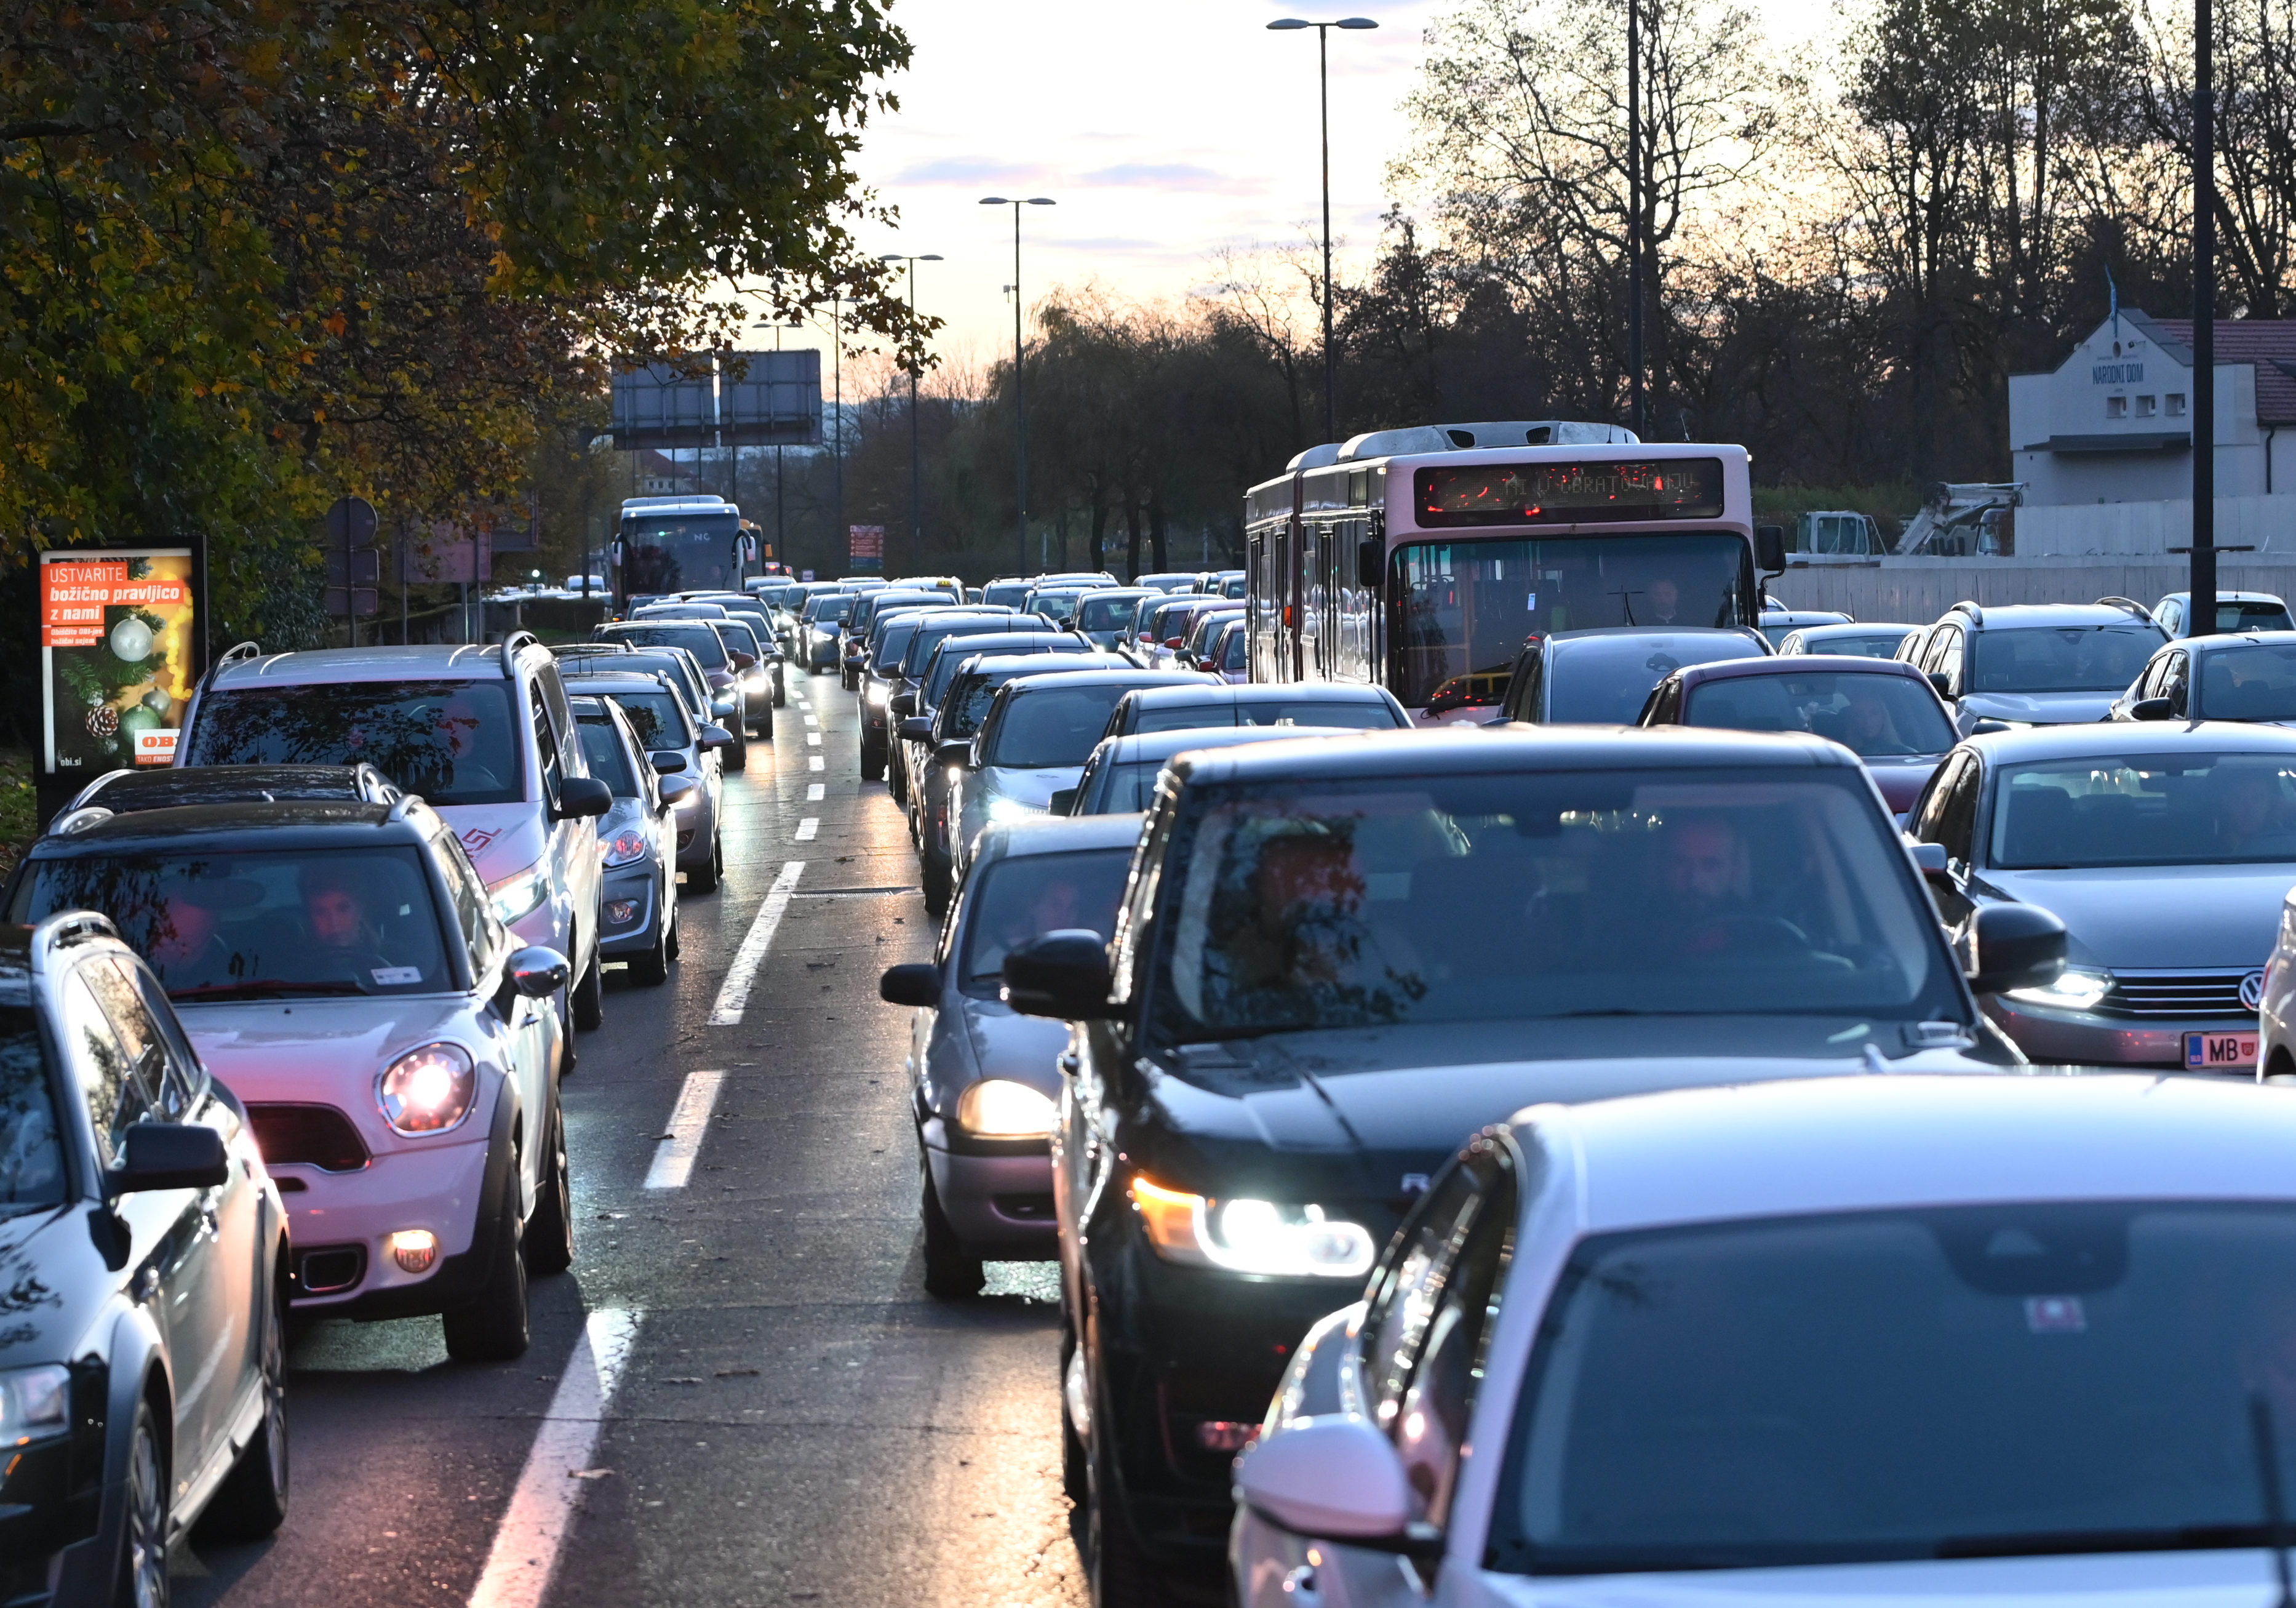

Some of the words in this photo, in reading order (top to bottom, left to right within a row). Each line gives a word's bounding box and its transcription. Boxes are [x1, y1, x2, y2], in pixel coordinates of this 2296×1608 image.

[2092, 365, 2124, 385] NARODNI
[2126, 363, 2143, 383] DOM
[50, 567, 123, 582] USTVARITE
[50, 586, 109, 601] božično
[113, 585, 180, 603] pravljico
[50, 609, 58, 620] z
[63, 606, 100, 620] nami
[142, 737, 177, 747] OB
[60, 757, 81, 766] obi.si
[2209, 1038, 2238, 1062] MB
